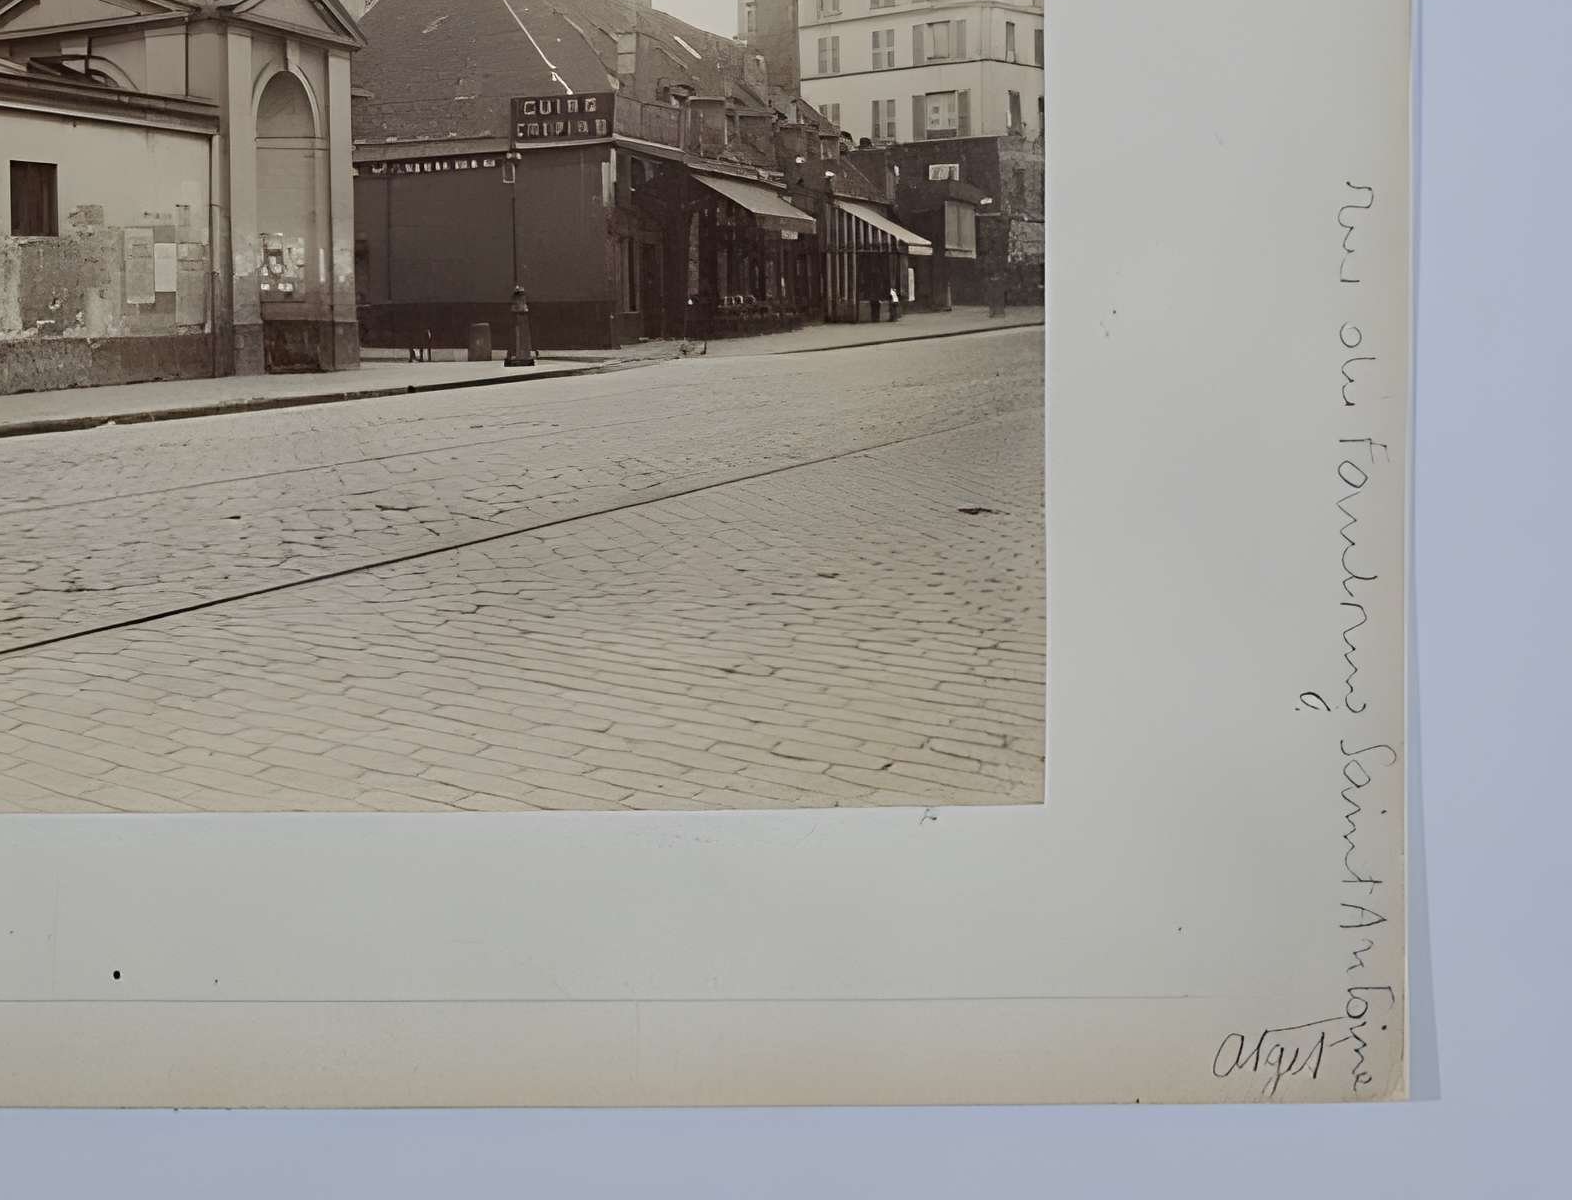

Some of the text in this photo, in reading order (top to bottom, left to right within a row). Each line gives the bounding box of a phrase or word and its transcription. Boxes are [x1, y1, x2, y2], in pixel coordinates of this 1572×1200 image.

[1339, 320, 1377, 407] du
[1340, 738, 1397, 895] Saint
[1339, 902, 1395, 1092] Antoine
